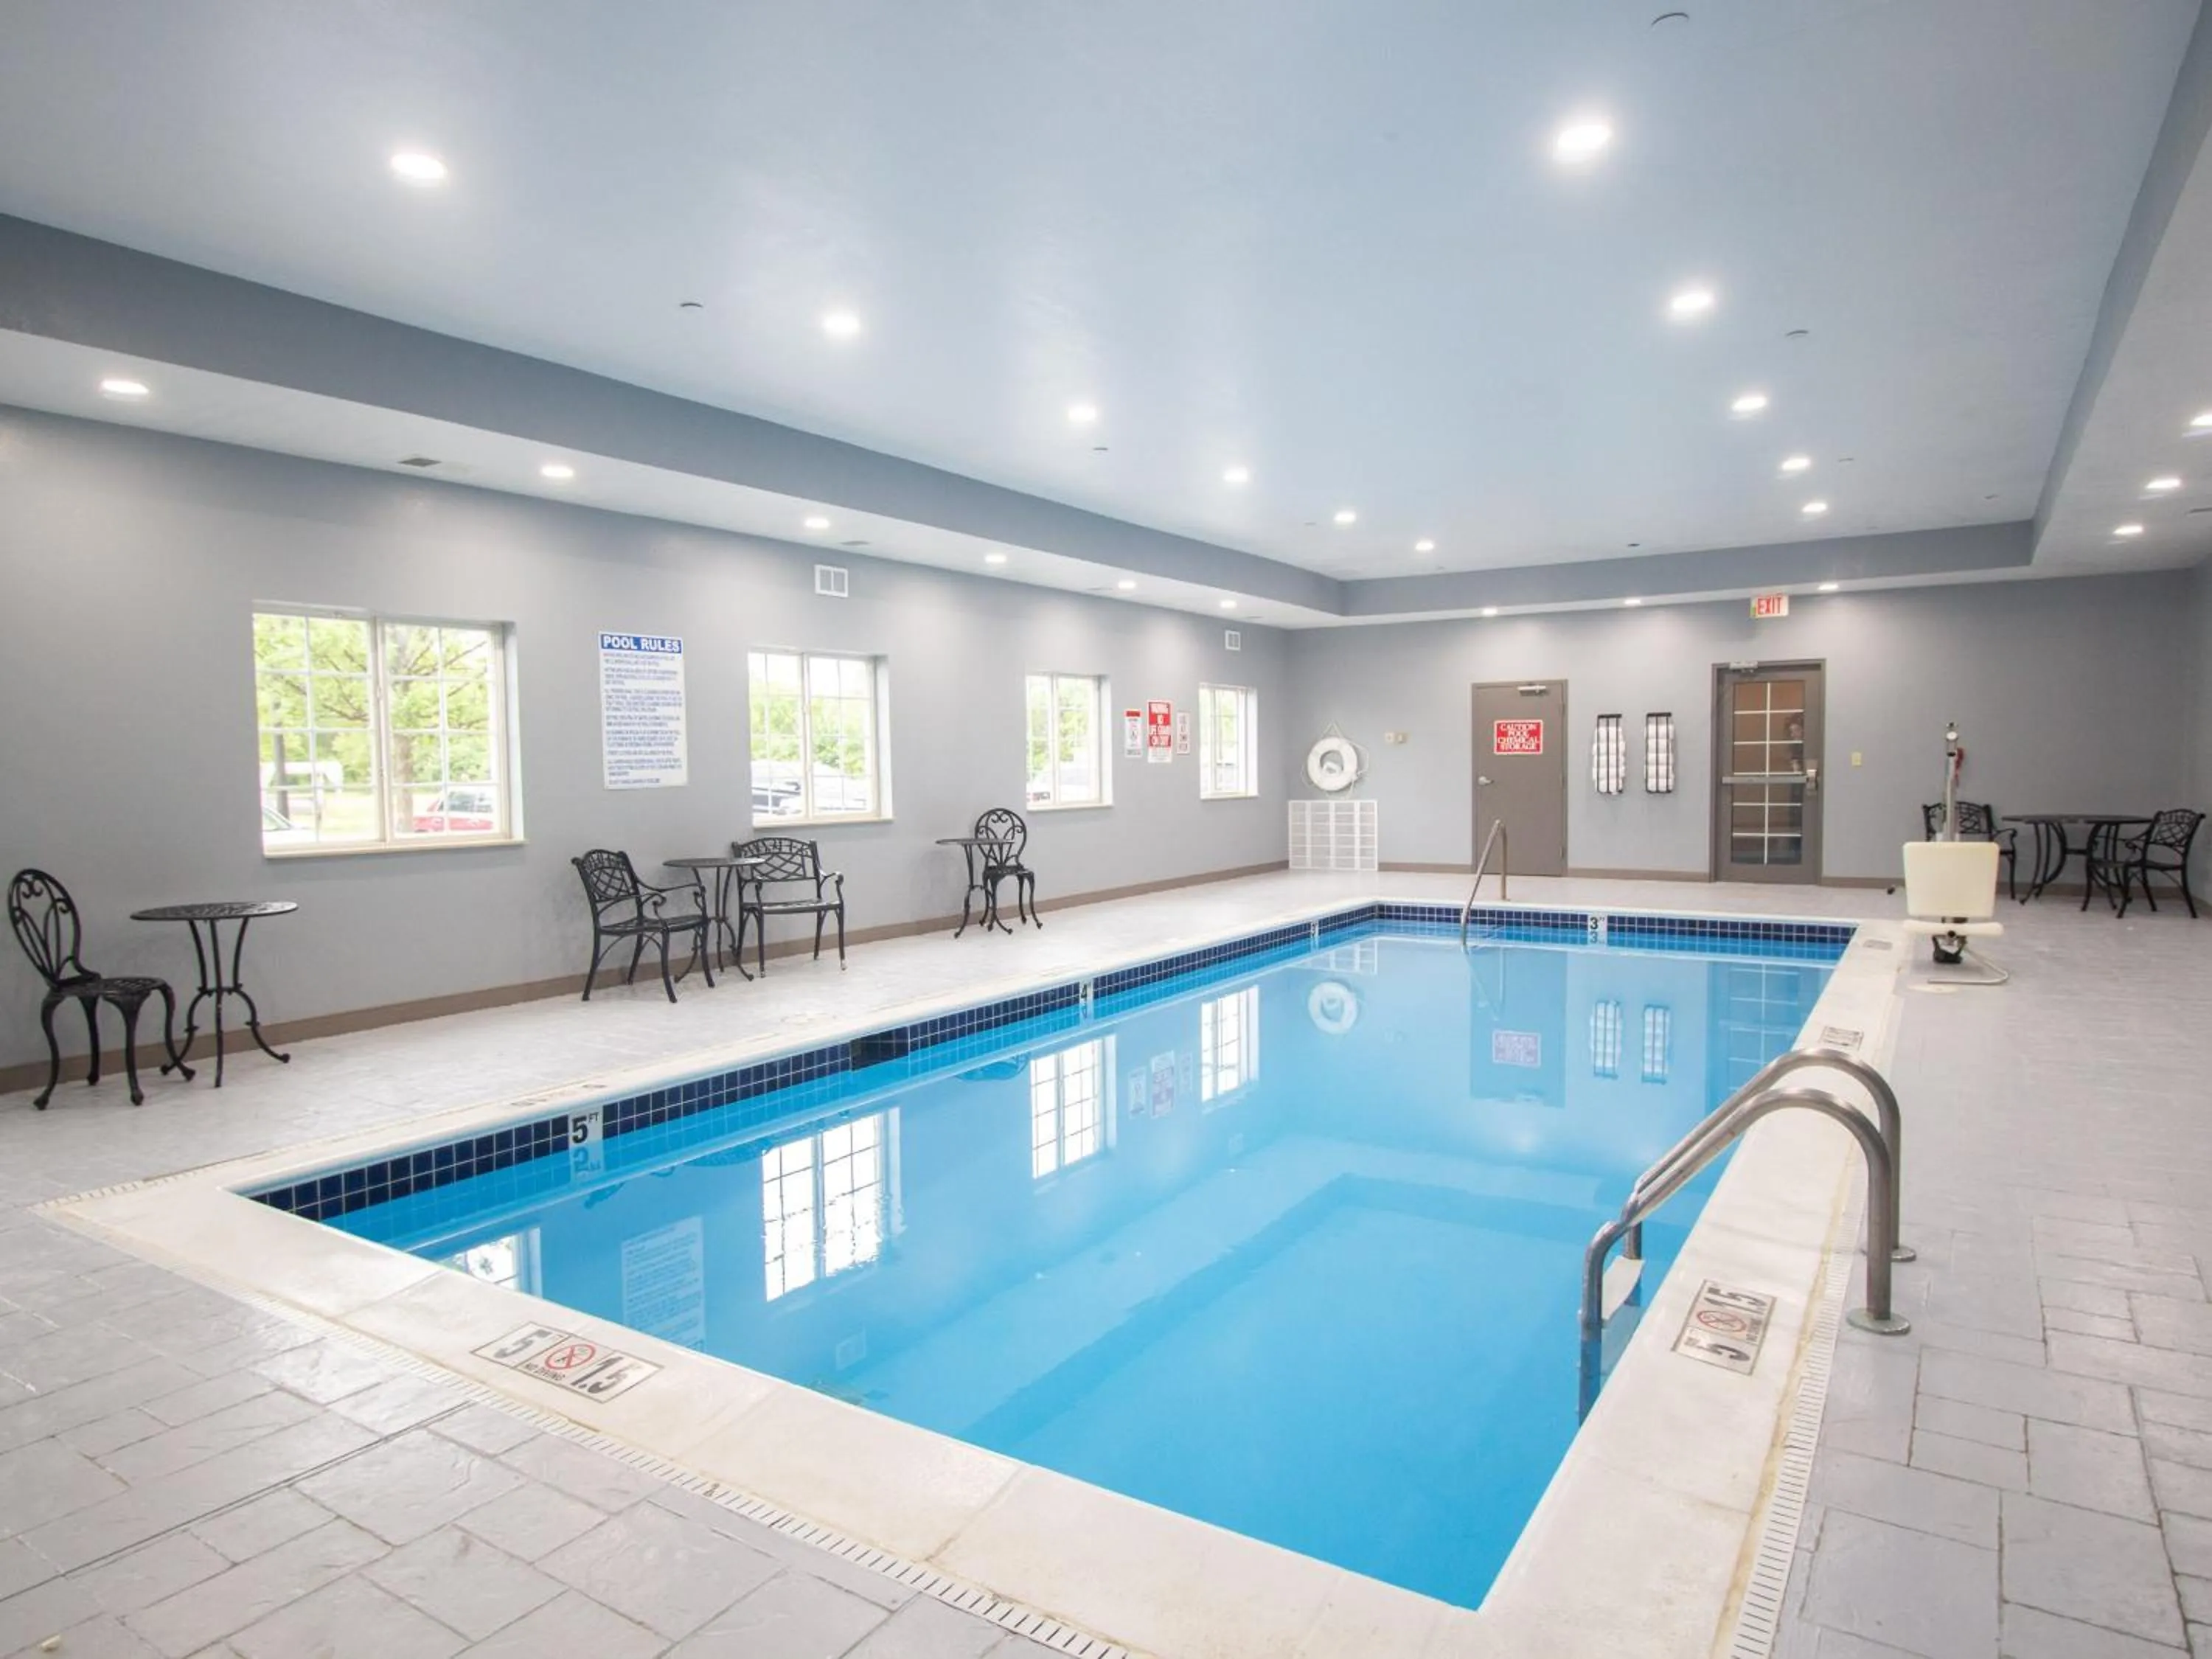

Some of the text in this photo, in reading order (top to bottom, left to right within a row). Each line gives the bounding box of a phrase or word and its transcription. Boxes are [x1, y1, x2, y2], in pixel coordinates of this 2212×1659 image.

[1757, 597, 1782, 615] EXIT
[603, 635, 680, 653] POOL RULES
[1500, 723, 1537, 731] CAUTION
[1590, 917, 1599, 930] 3
[572, 1116, 588, 1144] 5
[494, 1329, 552, 1358] 5
[1684, 1337, 1750, 1361] 5
